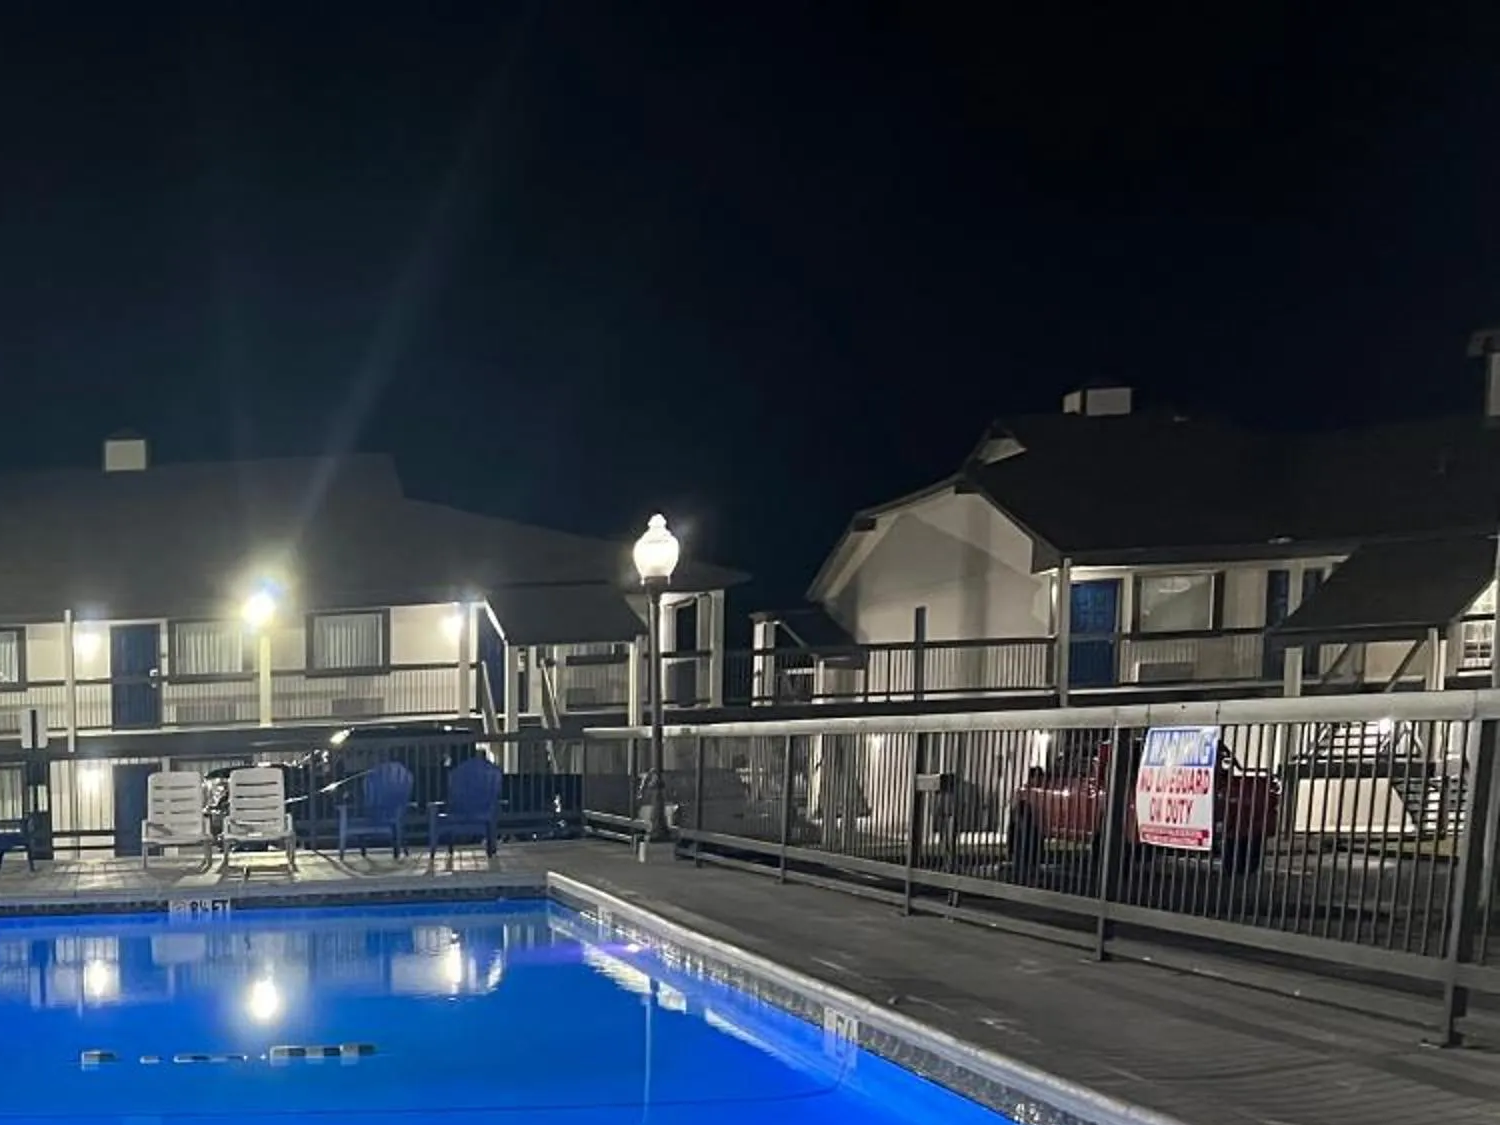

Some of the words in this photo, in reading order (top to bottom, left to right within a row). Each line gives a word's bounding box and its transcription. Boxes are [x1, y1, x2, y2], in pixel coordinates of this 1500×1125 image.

[1140, 768, 1155, 793] NO
[1156, 768, 1211, 795] LIFEGUARD
[1150, 797, 1164, 822] ON
[1165, 798, 1194, 824] DUTY
